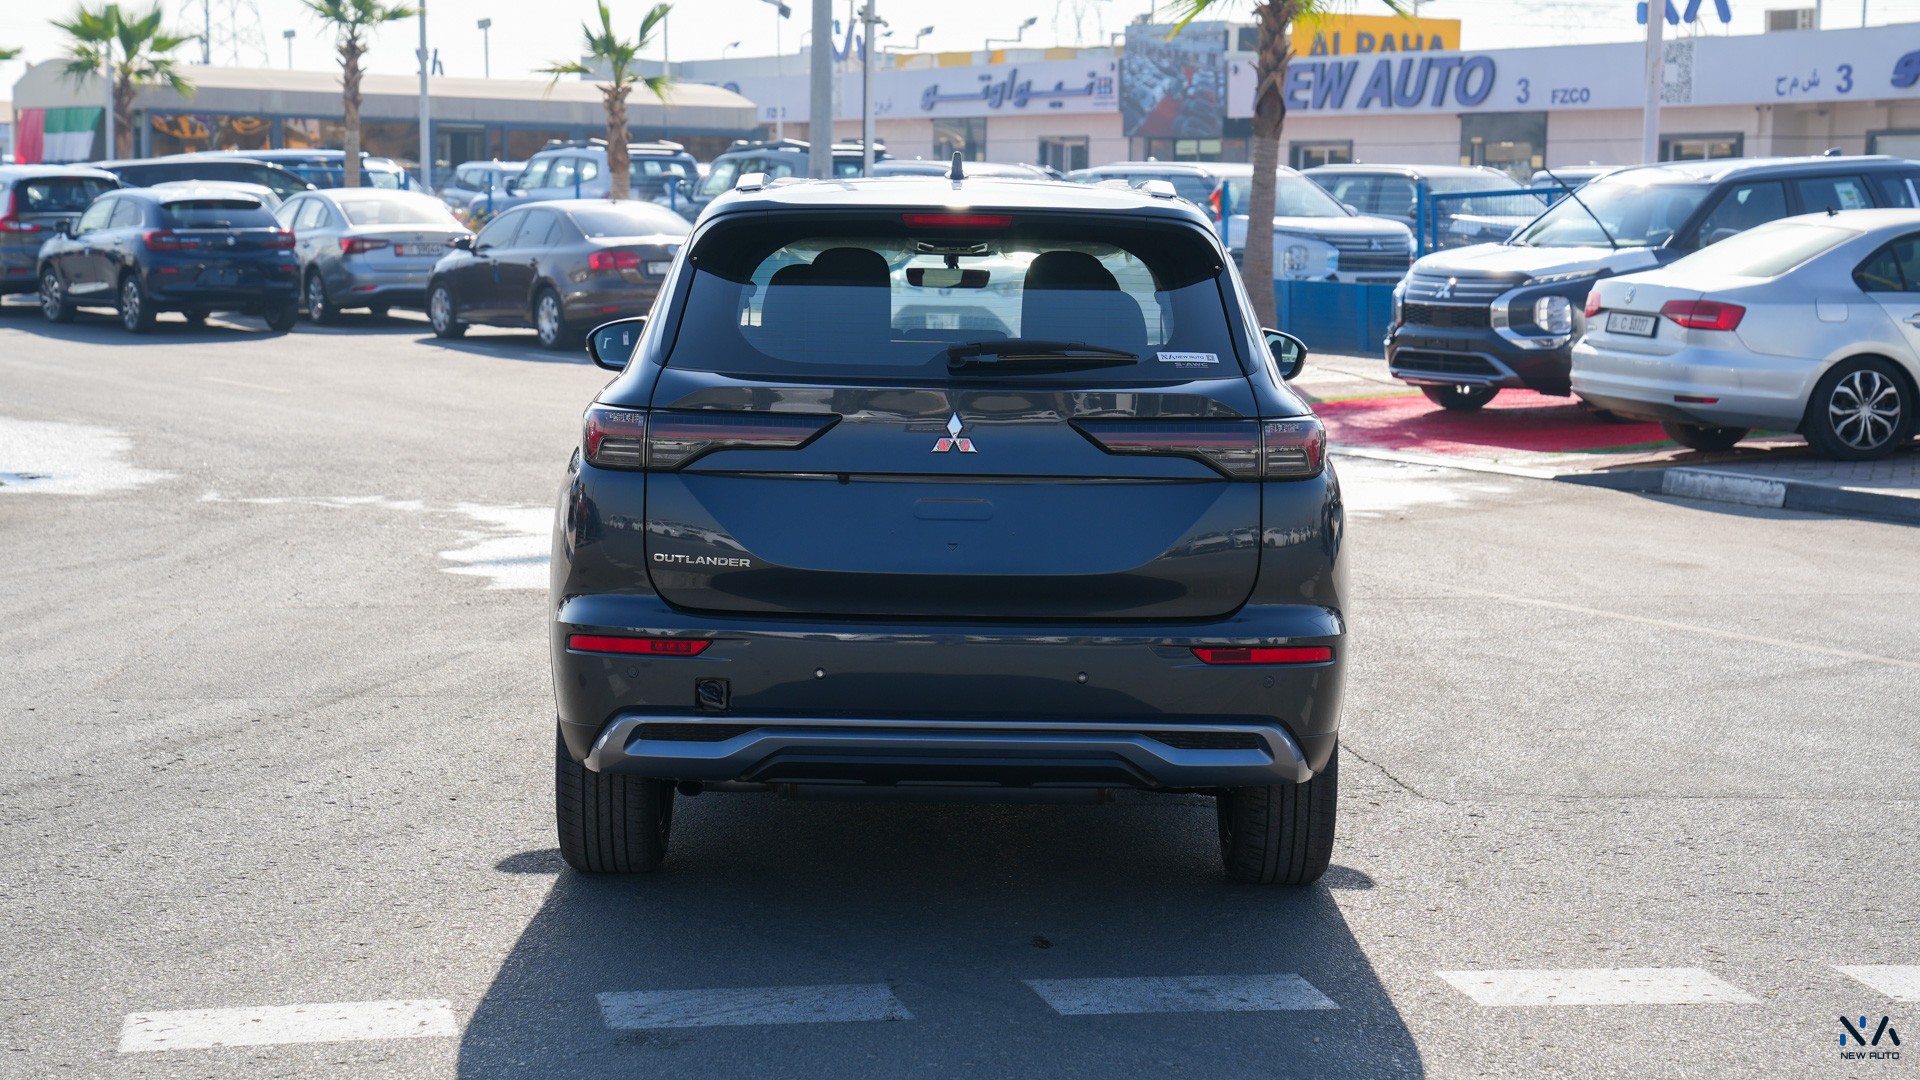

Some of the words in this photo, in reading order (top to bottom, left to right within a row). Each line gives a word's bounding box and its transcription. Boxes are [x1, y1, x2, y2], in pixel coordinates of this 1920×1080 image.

[1253, 61, 1359, 112] EW
[1356, 55, 1497, 109] AUTO
[1516, 78, 1530, 104] 3
[1551, 87, 1591, 104] FZCO
[1835, 63, 1853, 94] 3
[653, 553, 751, 568] OUTLANDER
